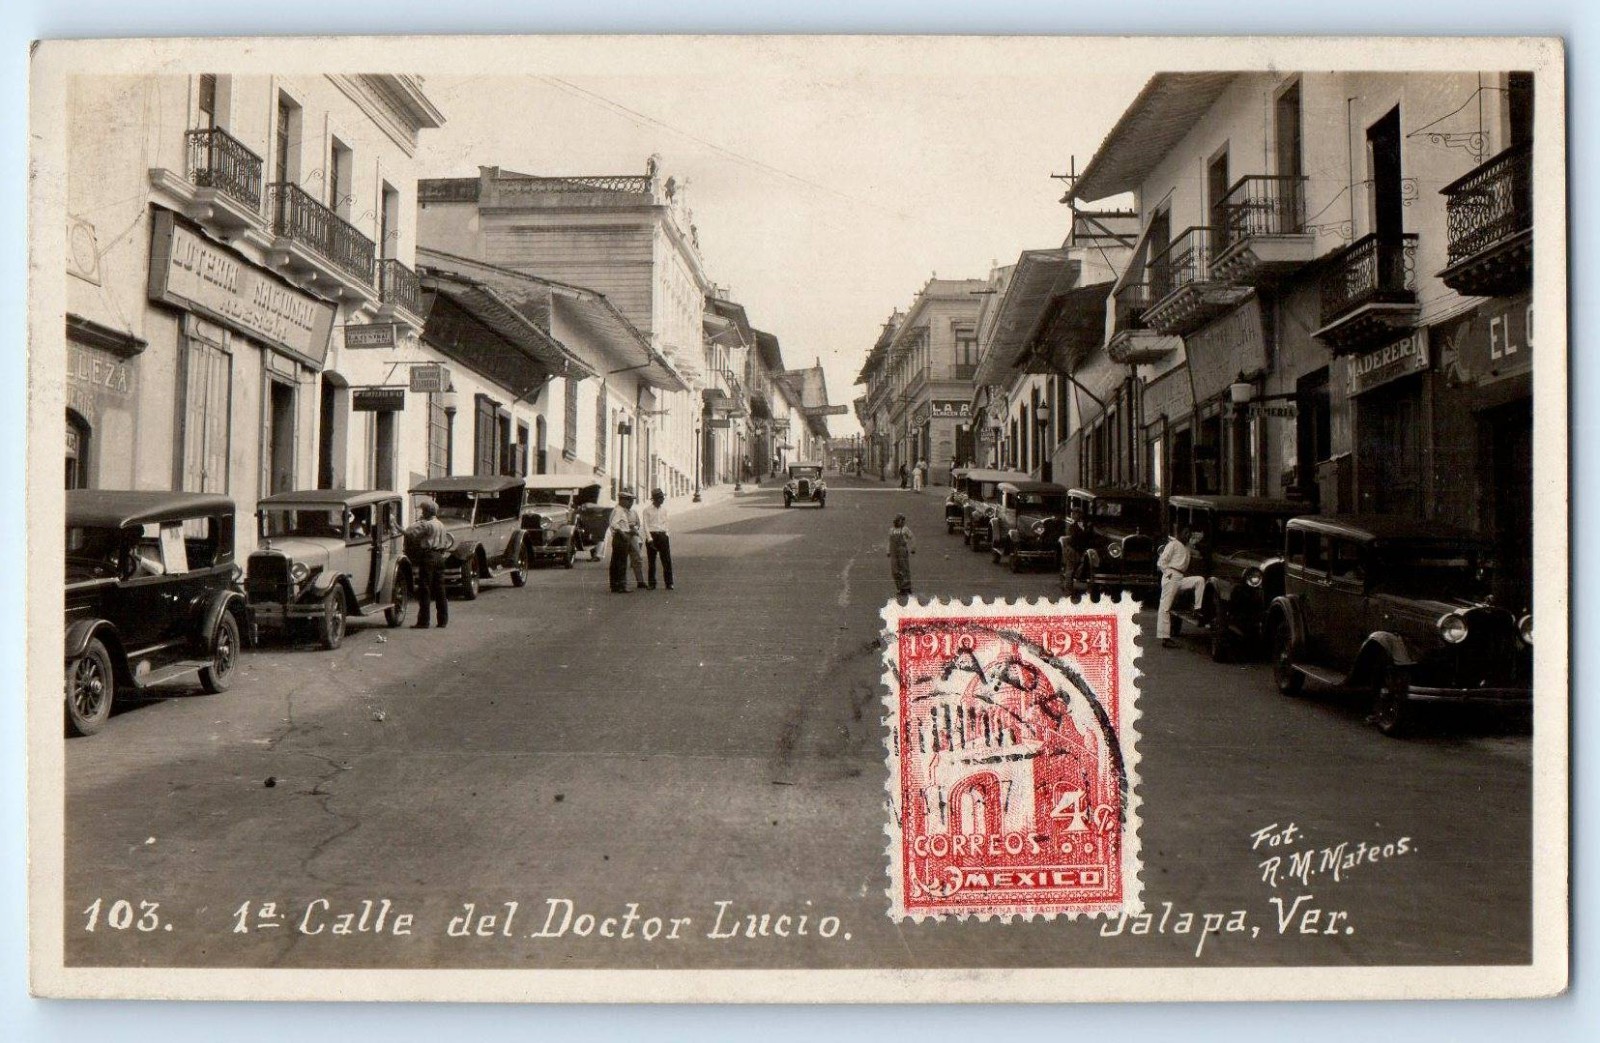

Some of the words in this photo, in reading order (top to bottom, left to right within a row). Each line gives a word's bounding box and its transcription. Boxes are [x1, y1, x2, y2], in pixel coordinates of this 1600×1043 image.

[1490, 313, 1517, 360] EL
[1042, 631, 1111, 657] 1934
[913, 834, 1041, 857] CORREOS
[963, 872, 1102, 888] MEXICO
